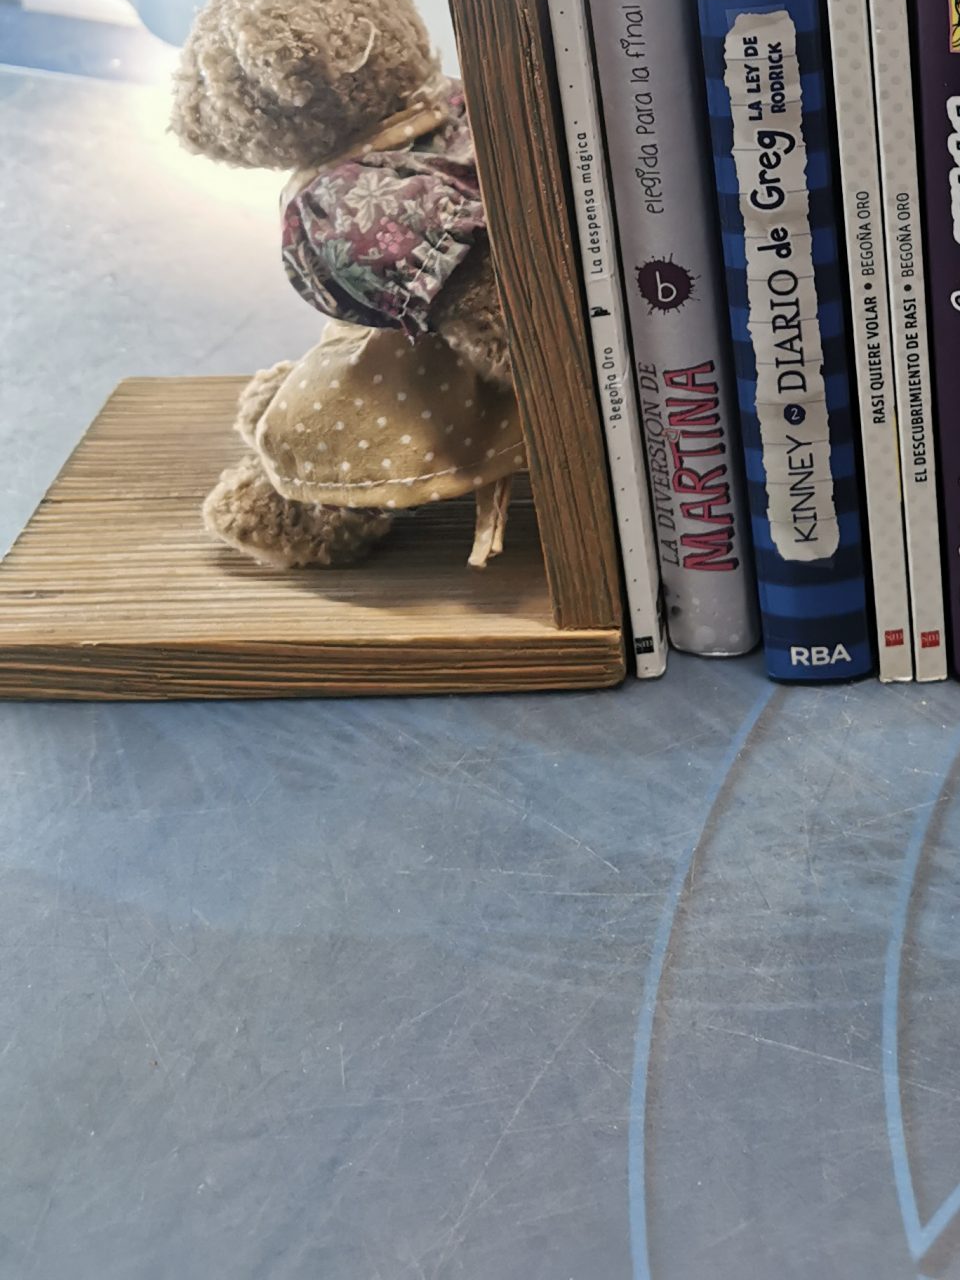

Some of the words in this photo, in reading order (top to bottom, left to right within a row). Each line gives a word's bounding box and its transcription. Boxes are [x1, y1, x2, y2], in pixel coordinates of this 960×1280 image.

[620, 5, 645, 59] final
[743, 35, 758, 57] DE
[630, 66, 650, 83] la
[746, 63, 761, 94] LEY
[767, 42, 787, 114] RODRICK
[748, 100, 763, 121] LA
[576, 132, 593, 184] mágica
[750, 130, 796, 211] Greg
[635, 143, 664, 214] elegida
[584, 189, 601, 254] despensa
[856, 191, 871, 220] ORO
[896, 192, 911, 220] ORO
[757, 226, 792, 259] de
[857, 222, 875, 276] BEGOÑA
[897, 224, 914, 278] BEGOÑA
[591, 258, 603, 274] La
[864, 296, 879, 340] VOLAR
[903, 297, 918, 329] RASI
[767, 269, 807, 394] DIARIO
[906, 332, 919, 349] DE
[602, 347, 616, 370] Oro
[867, 342, 885, 391] QUIERE
[638, 362, 659, 393] DE
[605, 374, 623, 421] Begoña
[872, 394, 886, 424] RASI
[907, 352, 926, 466] DESCUBRIMIENTO
[790, 407, 801, 421] 2
[662, 359, 740, 571] MARTINA
[915, 468, 928, 483] EL
[785, 434, 819, 543] KINNEY
[661, 539, 680, 567] LA
[790, 643, 851, 666] RBA
